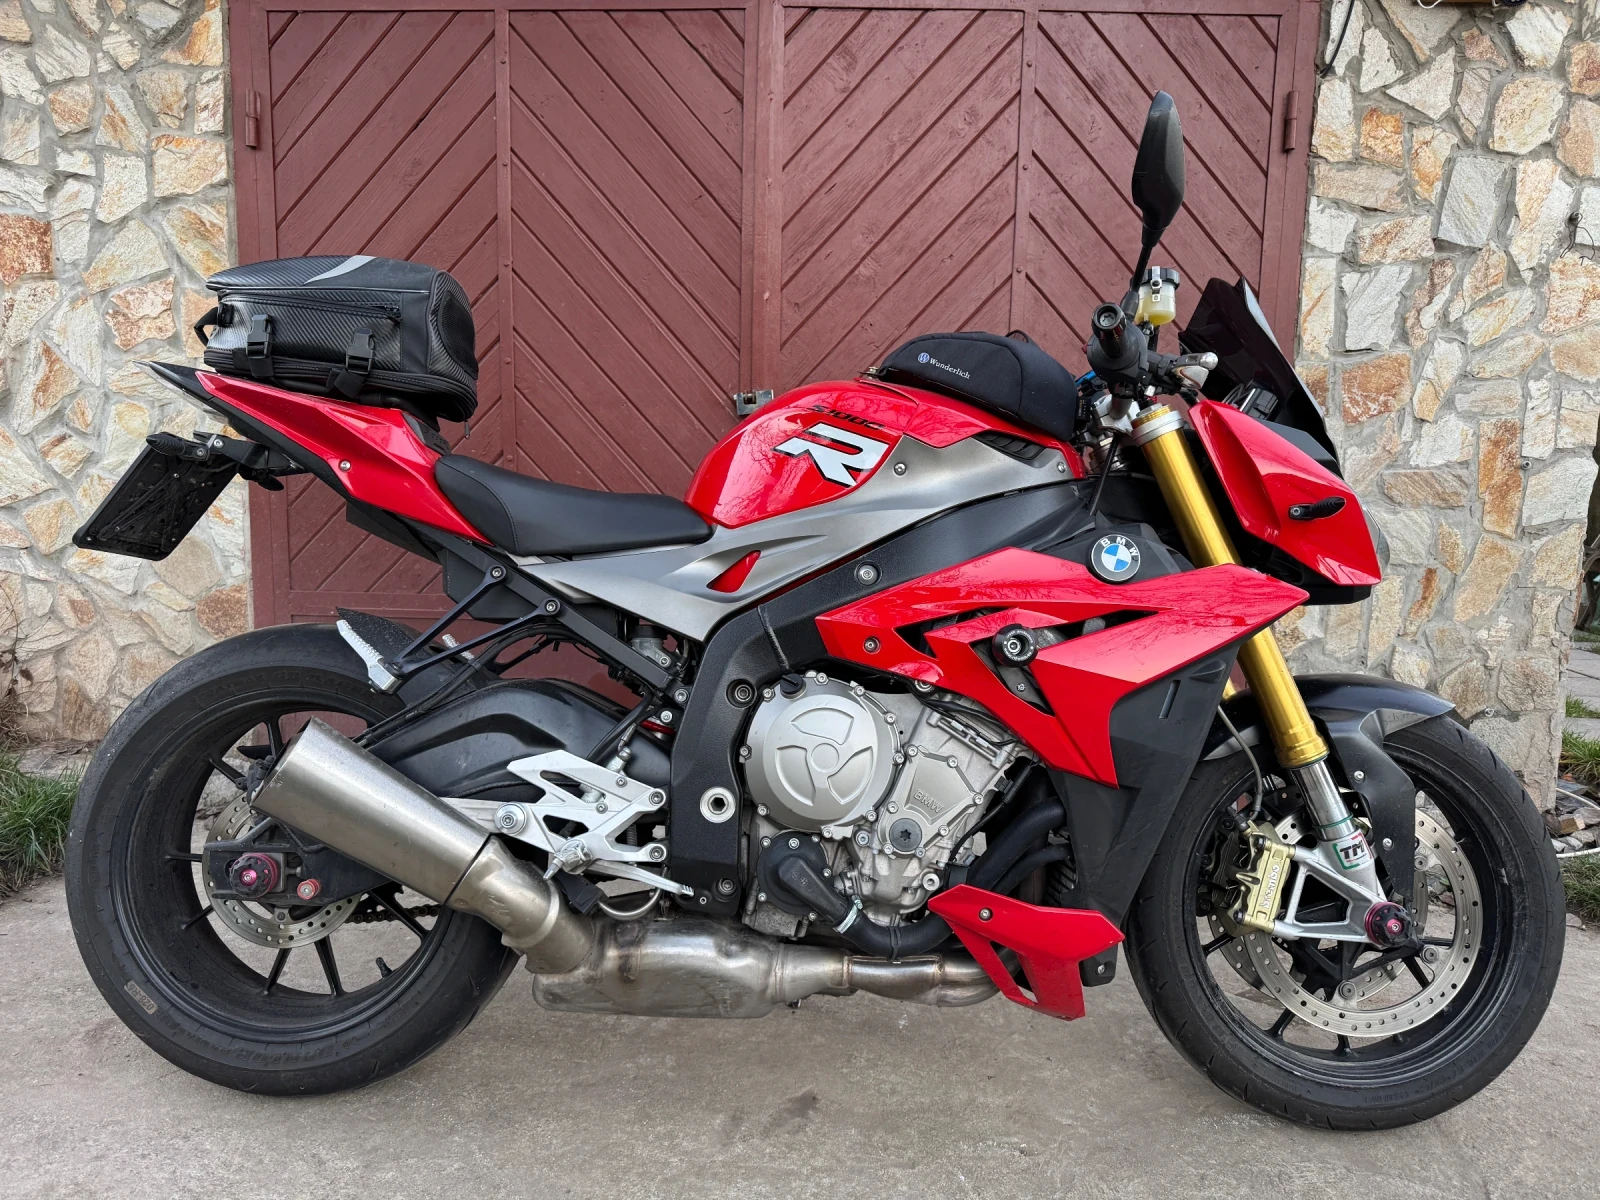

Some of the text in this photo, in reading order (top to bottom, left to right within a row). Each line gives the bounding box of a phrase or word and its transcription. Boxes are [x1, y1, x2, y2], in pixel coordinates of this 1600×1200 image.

[930, 357, 971, 380] Wunderlich
[773, 421, 892, 488] R
[1100, 536, 1140, 557] BMW
[913, 788, 945, 814] BMW
[1339, 839, 1365, 860] TM
[1260, 864, 1280, 909] brembo
